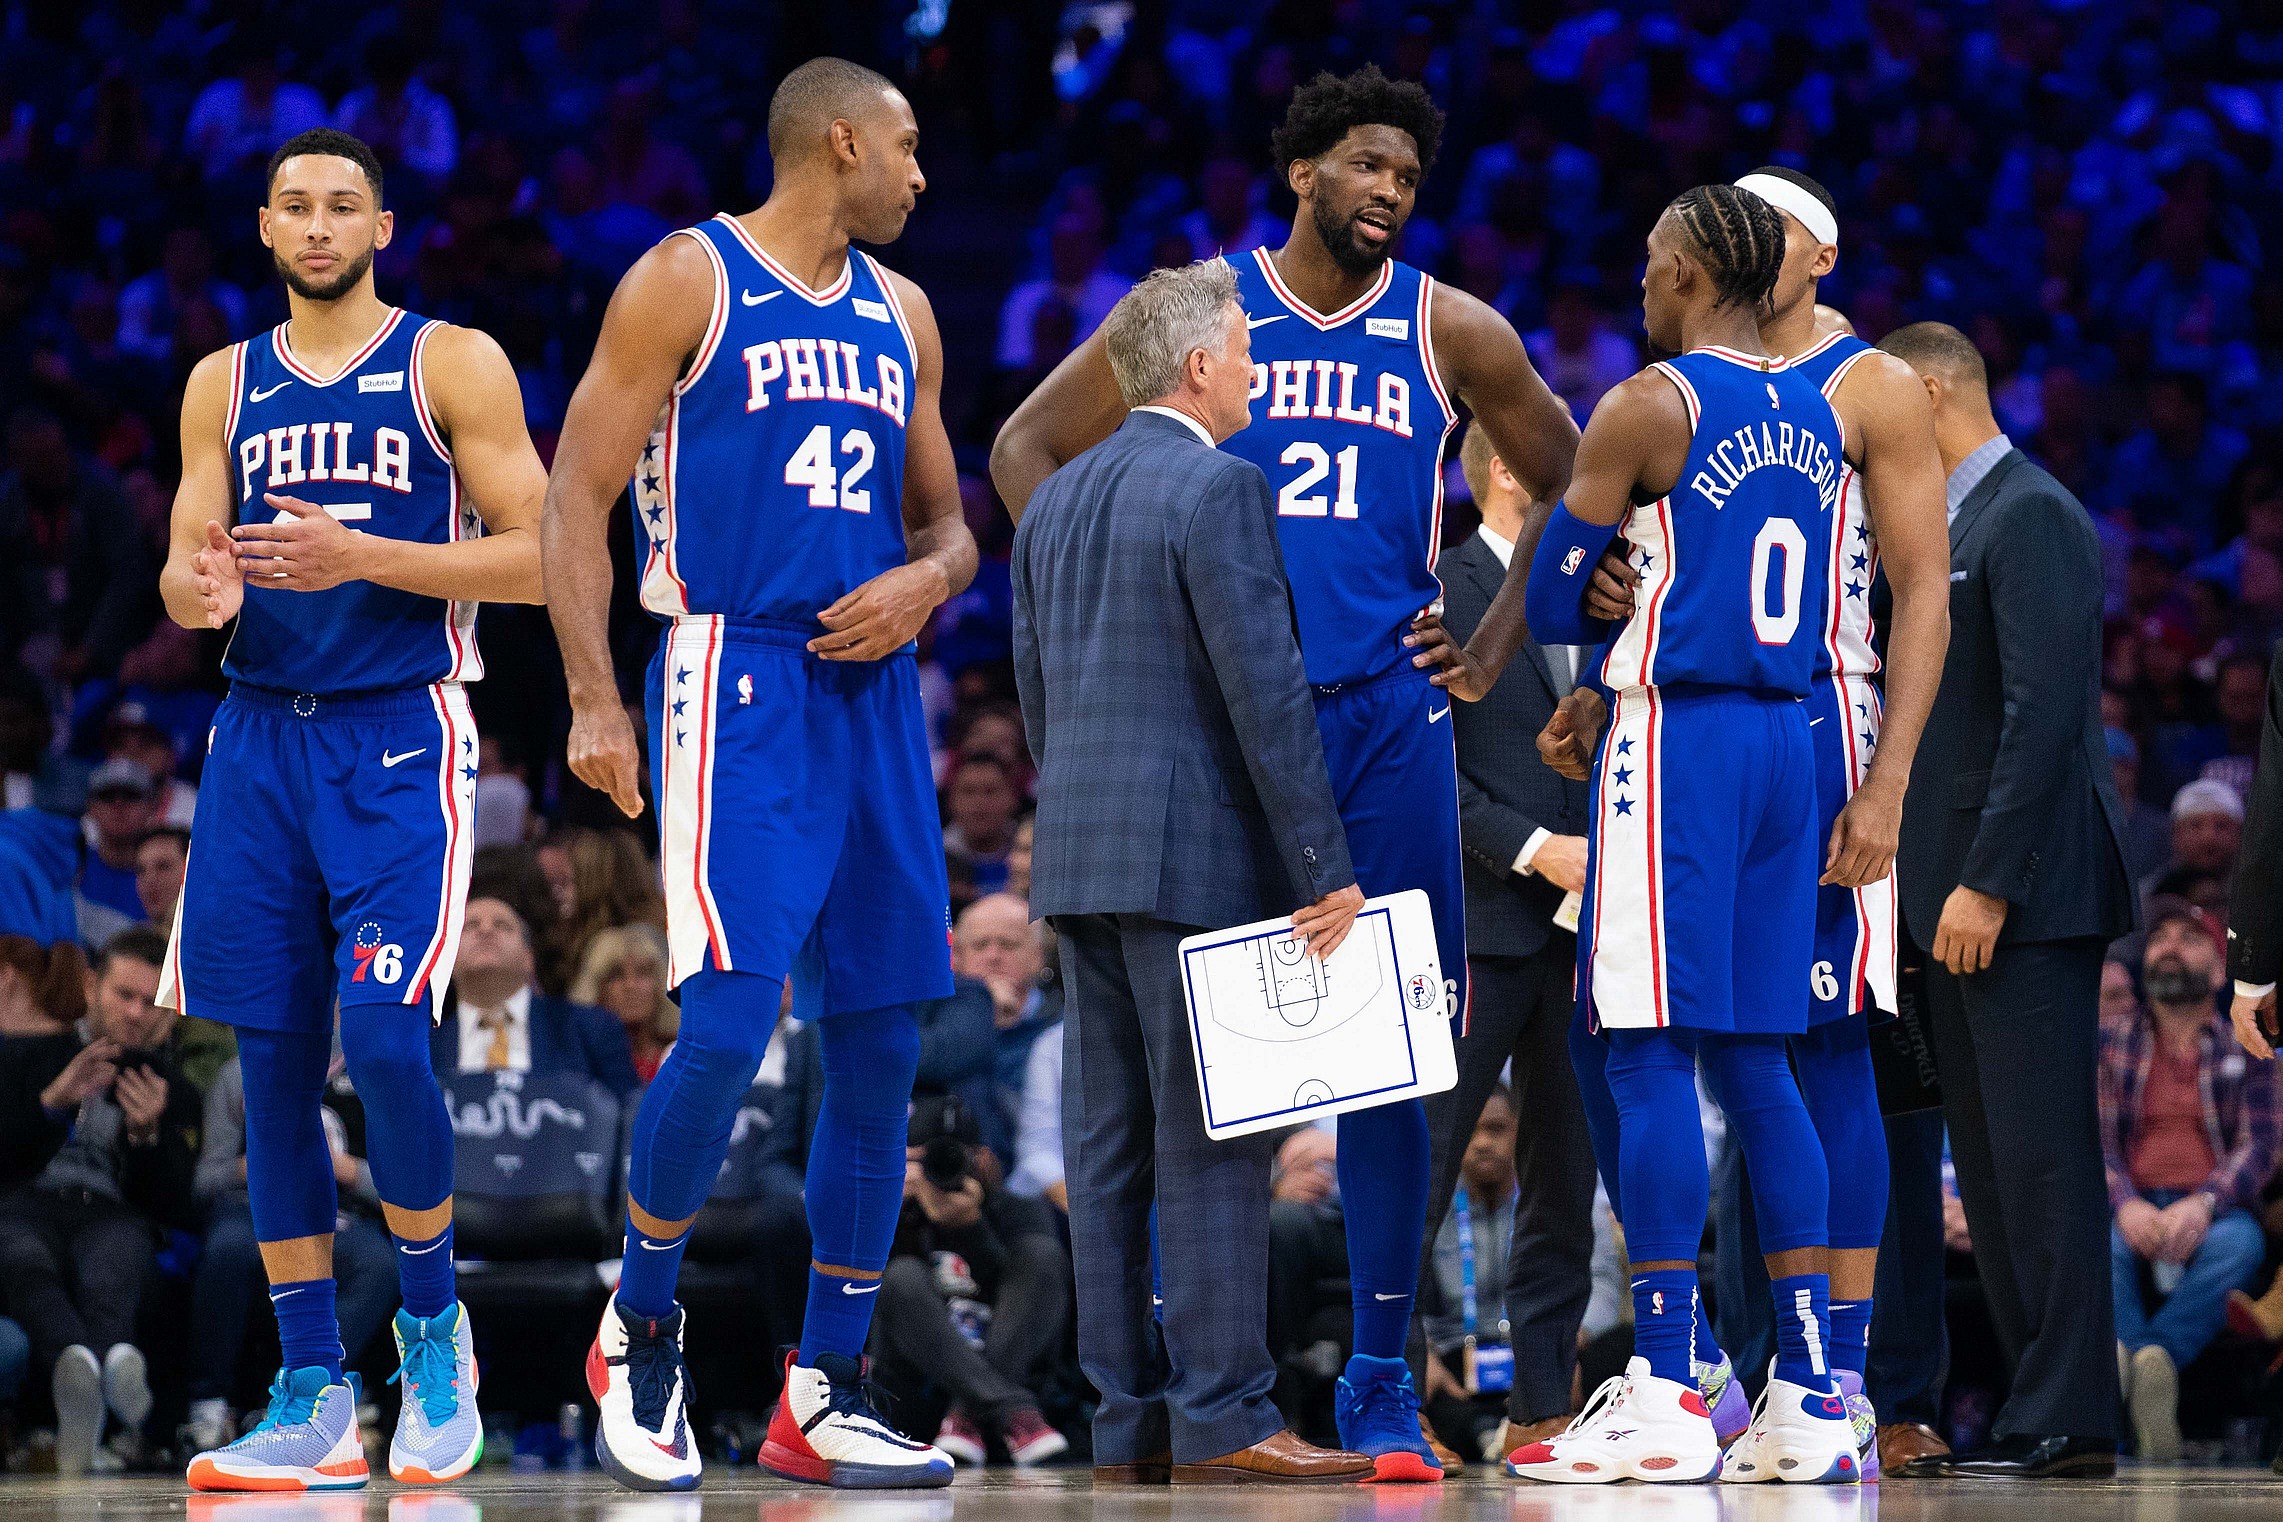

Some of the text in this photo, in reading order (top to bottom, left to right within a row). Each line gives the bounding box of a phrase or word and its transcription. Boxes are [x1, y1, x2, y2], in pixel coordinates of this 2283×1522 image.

[1371, 322, 1403, 333] StubHub
[364, 380, 398, 388] StubHub
[741, 338, 905, 428] PHILA
[240, 422, 412, 503] PHILA
[784, 425, 876, 514] 42
[1277, 441, 1359, 519] 21
[1691, 421, 1836, 512] RICHARDSON
[1750, 516, 1807, 647] 0
[352, 943, 404, 984] 76
